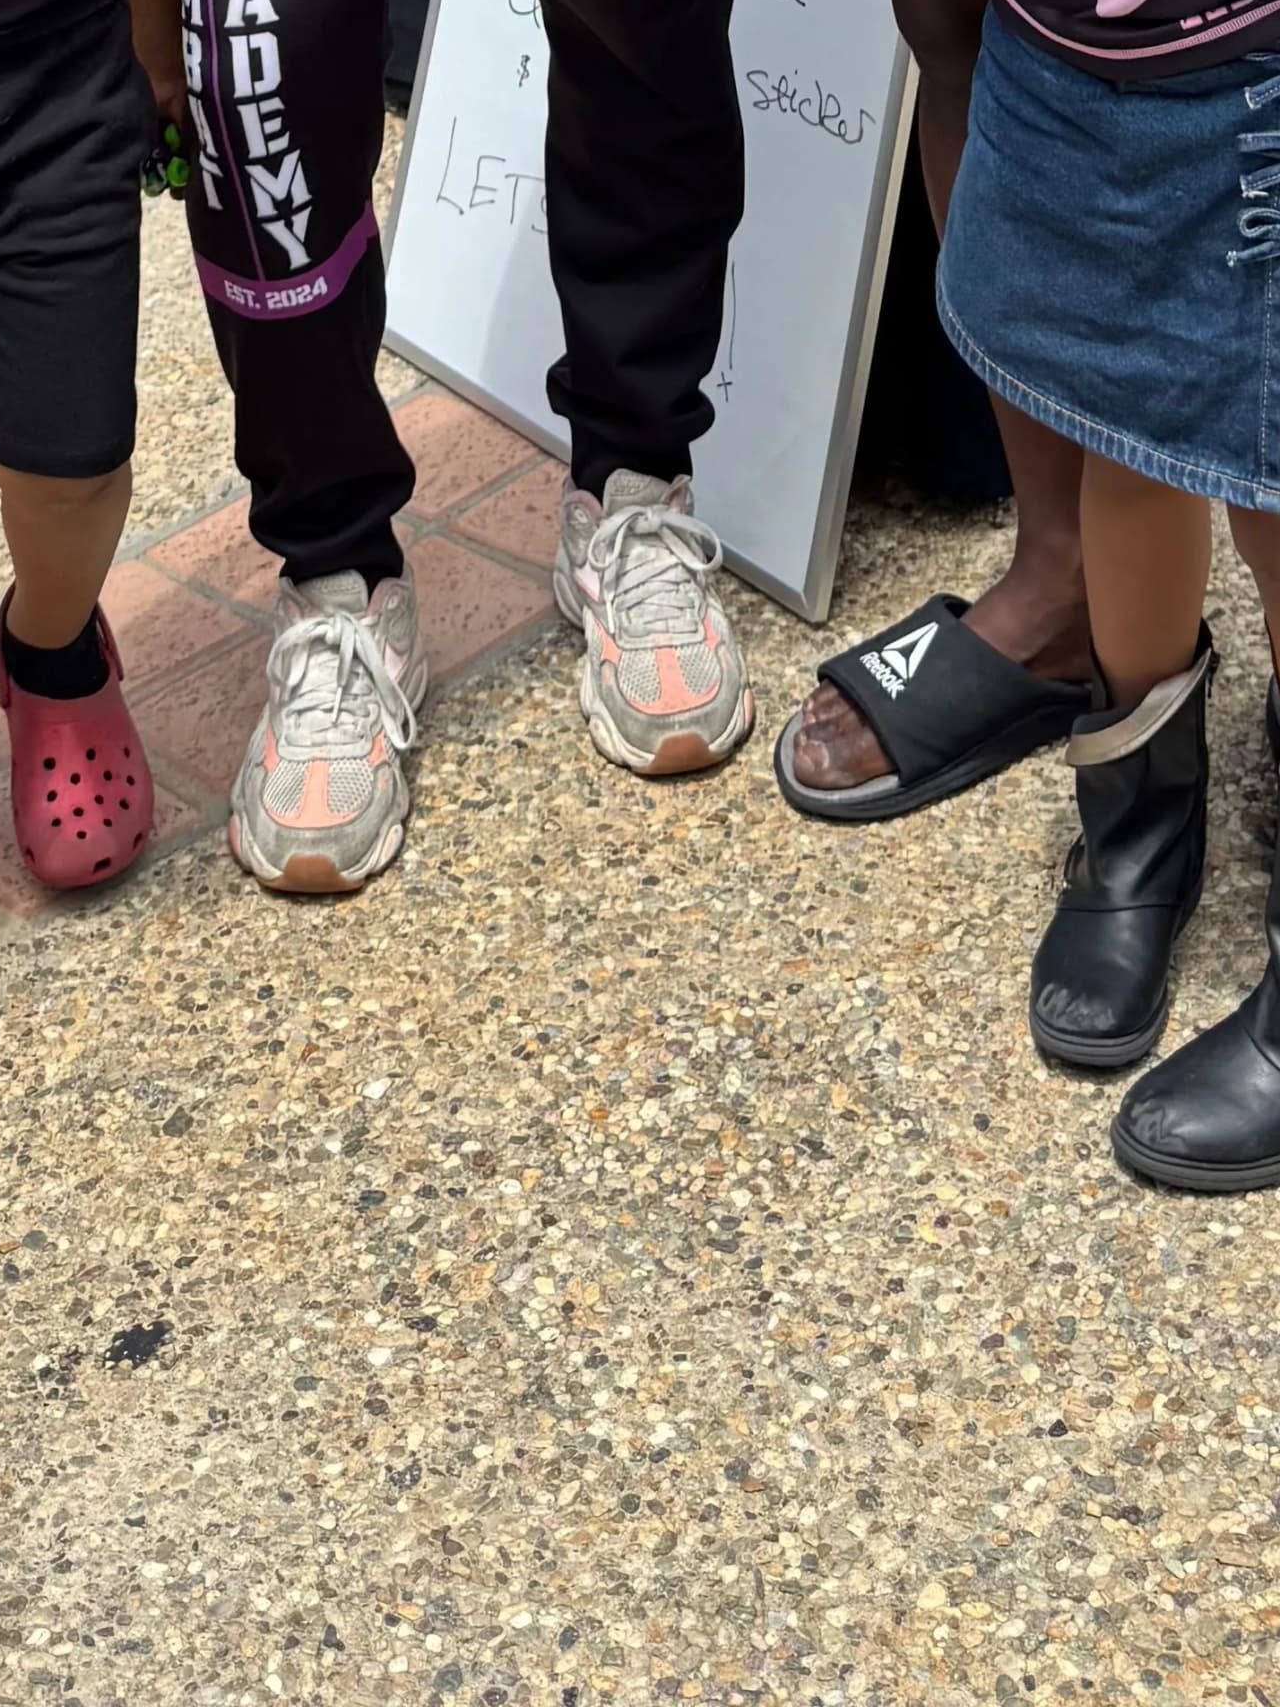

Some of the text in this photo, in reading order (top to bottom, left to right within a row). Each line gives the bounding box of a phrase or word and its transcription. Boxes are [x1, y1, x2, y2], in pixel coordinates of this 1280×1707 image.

[224, 275, 328, 309] EST. 2024
[859, 651, 905, 701] Reebok
